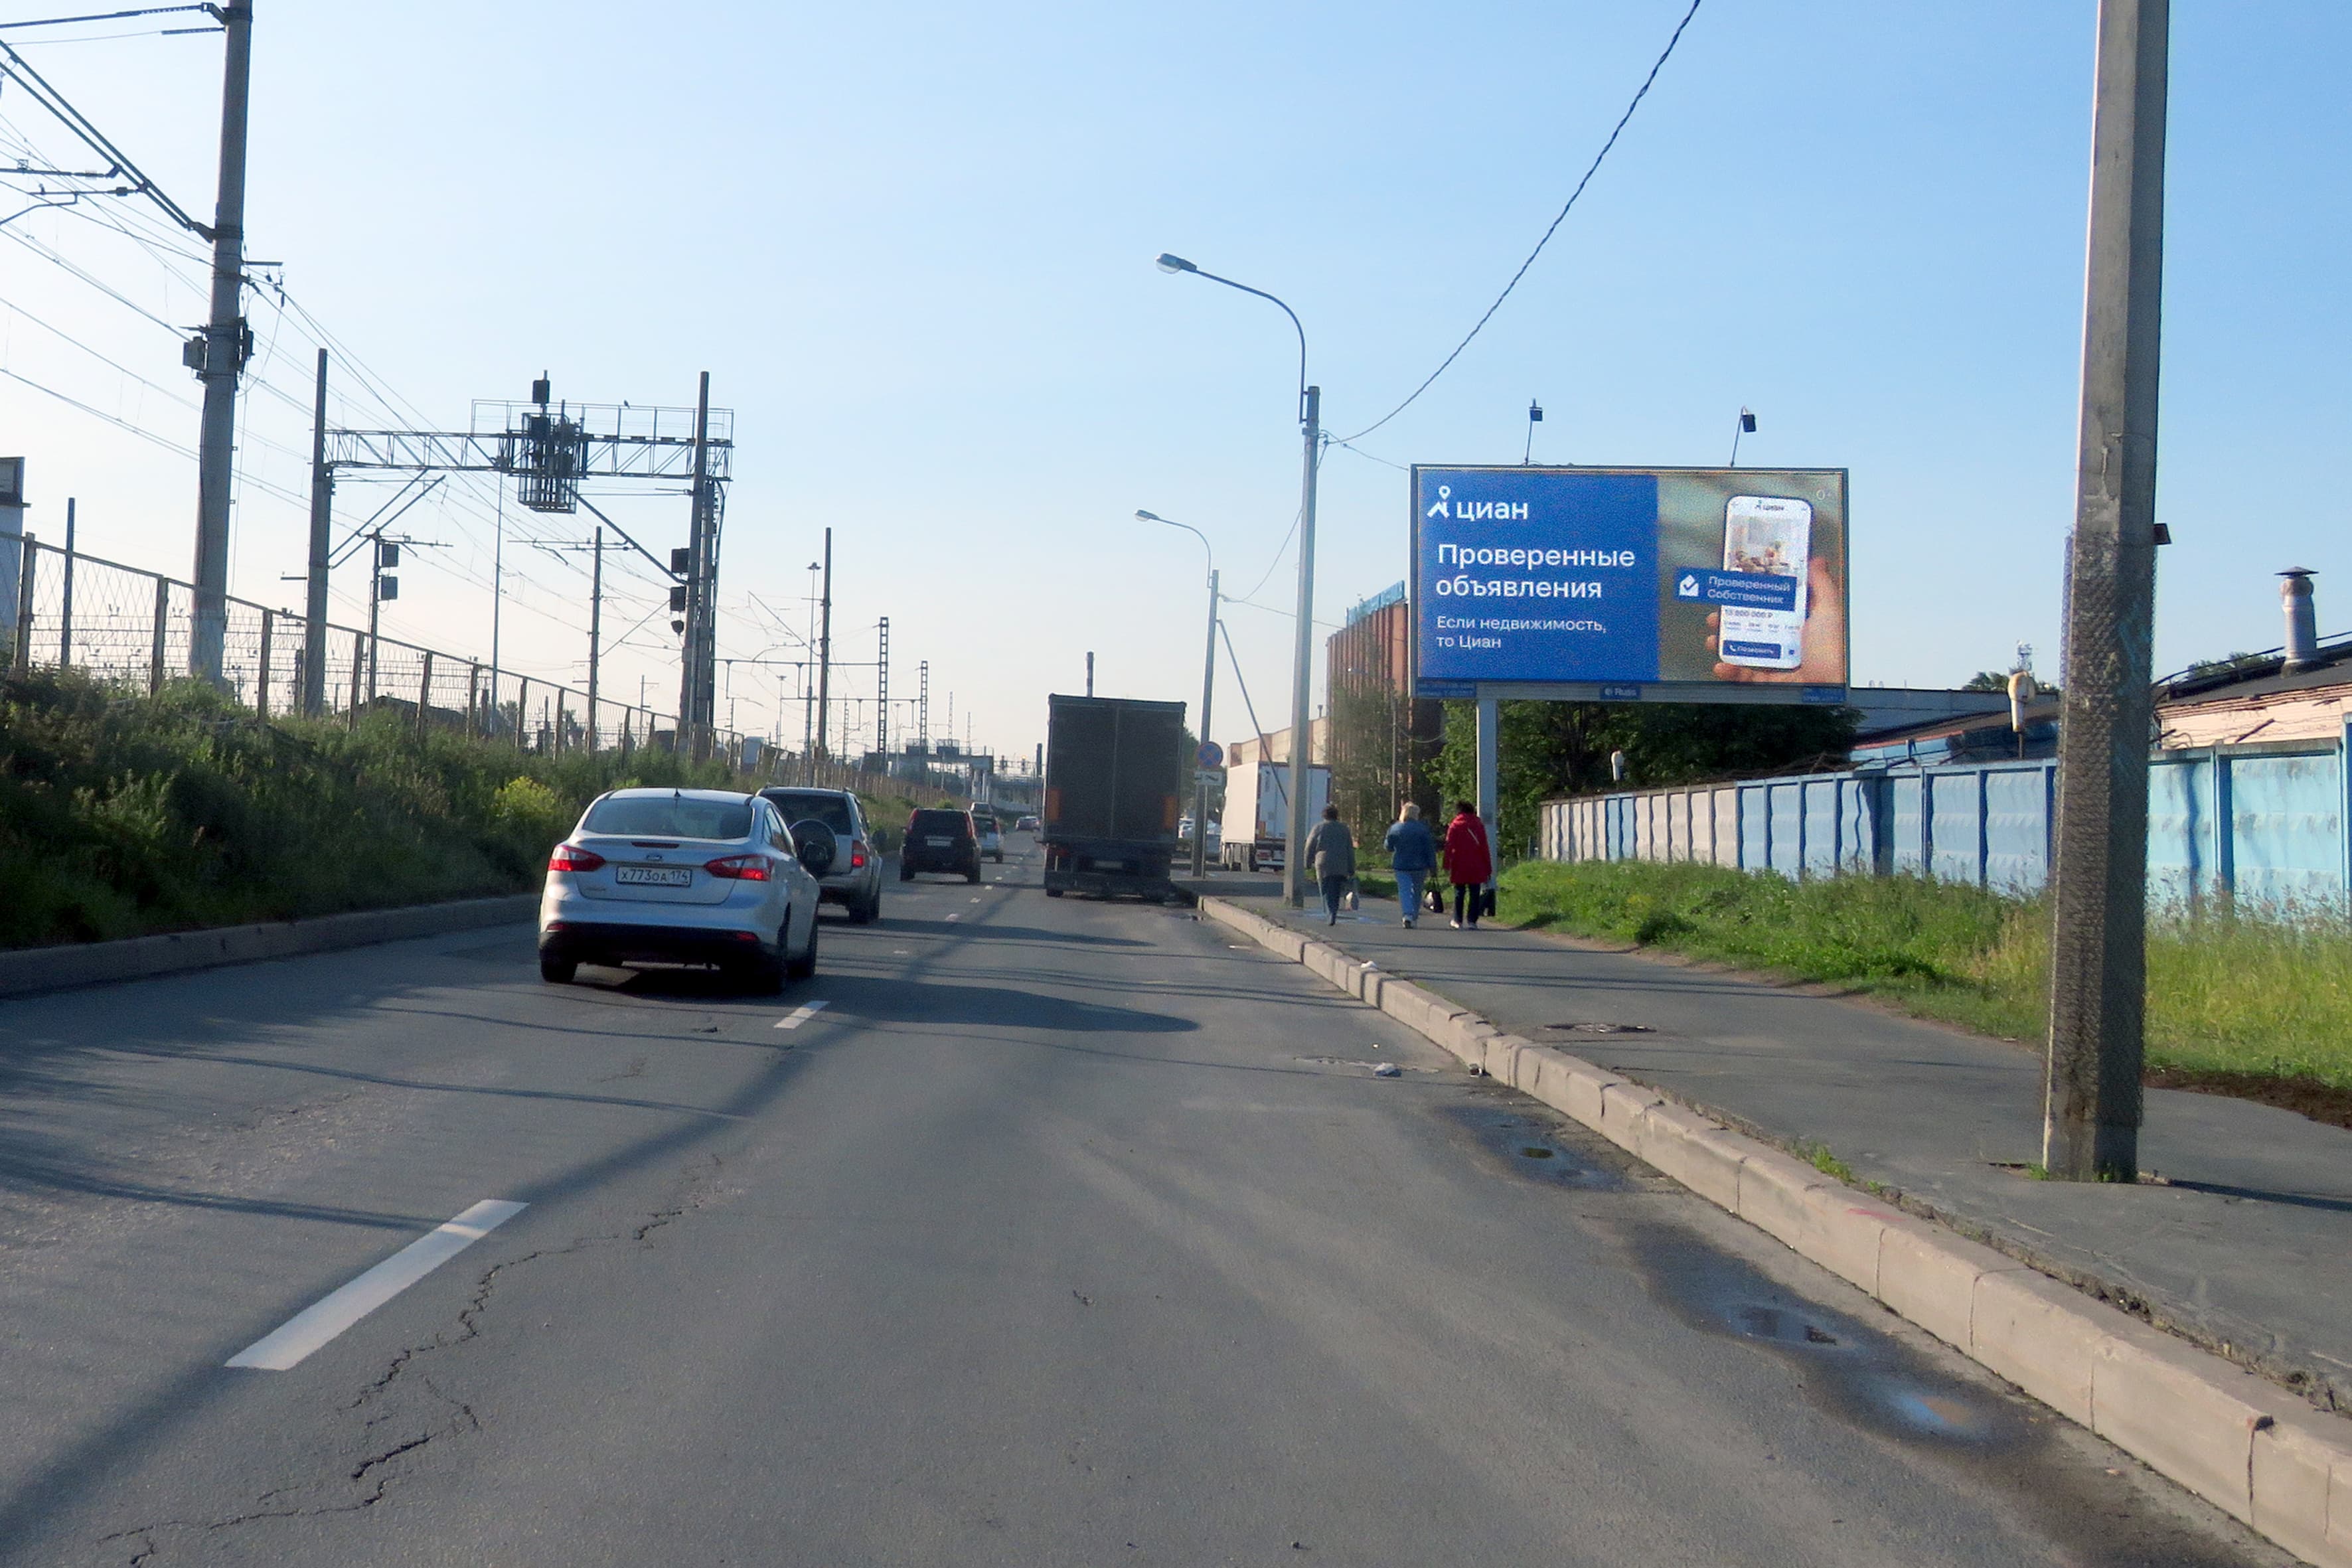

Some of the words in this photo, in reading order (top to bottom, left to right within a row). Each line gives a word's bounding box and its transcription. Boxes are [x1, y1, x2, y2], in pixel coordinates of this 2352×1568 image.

[1456, 502, 1528, 521] циан
[1438, 544, 1636, 570] Проверенные
[1436, 575, 1602, 598] объявления
[1708, 576, 1791, 592] Проверенный
[1707, 589, 1784, 604] Собственник
[1437, 615, 1476, 629] Если
[1480, 617, 1607, 634] недвижимость,
[1437, 636, 1455, 648] то
[1459, 635, 1502, 650] Циан
